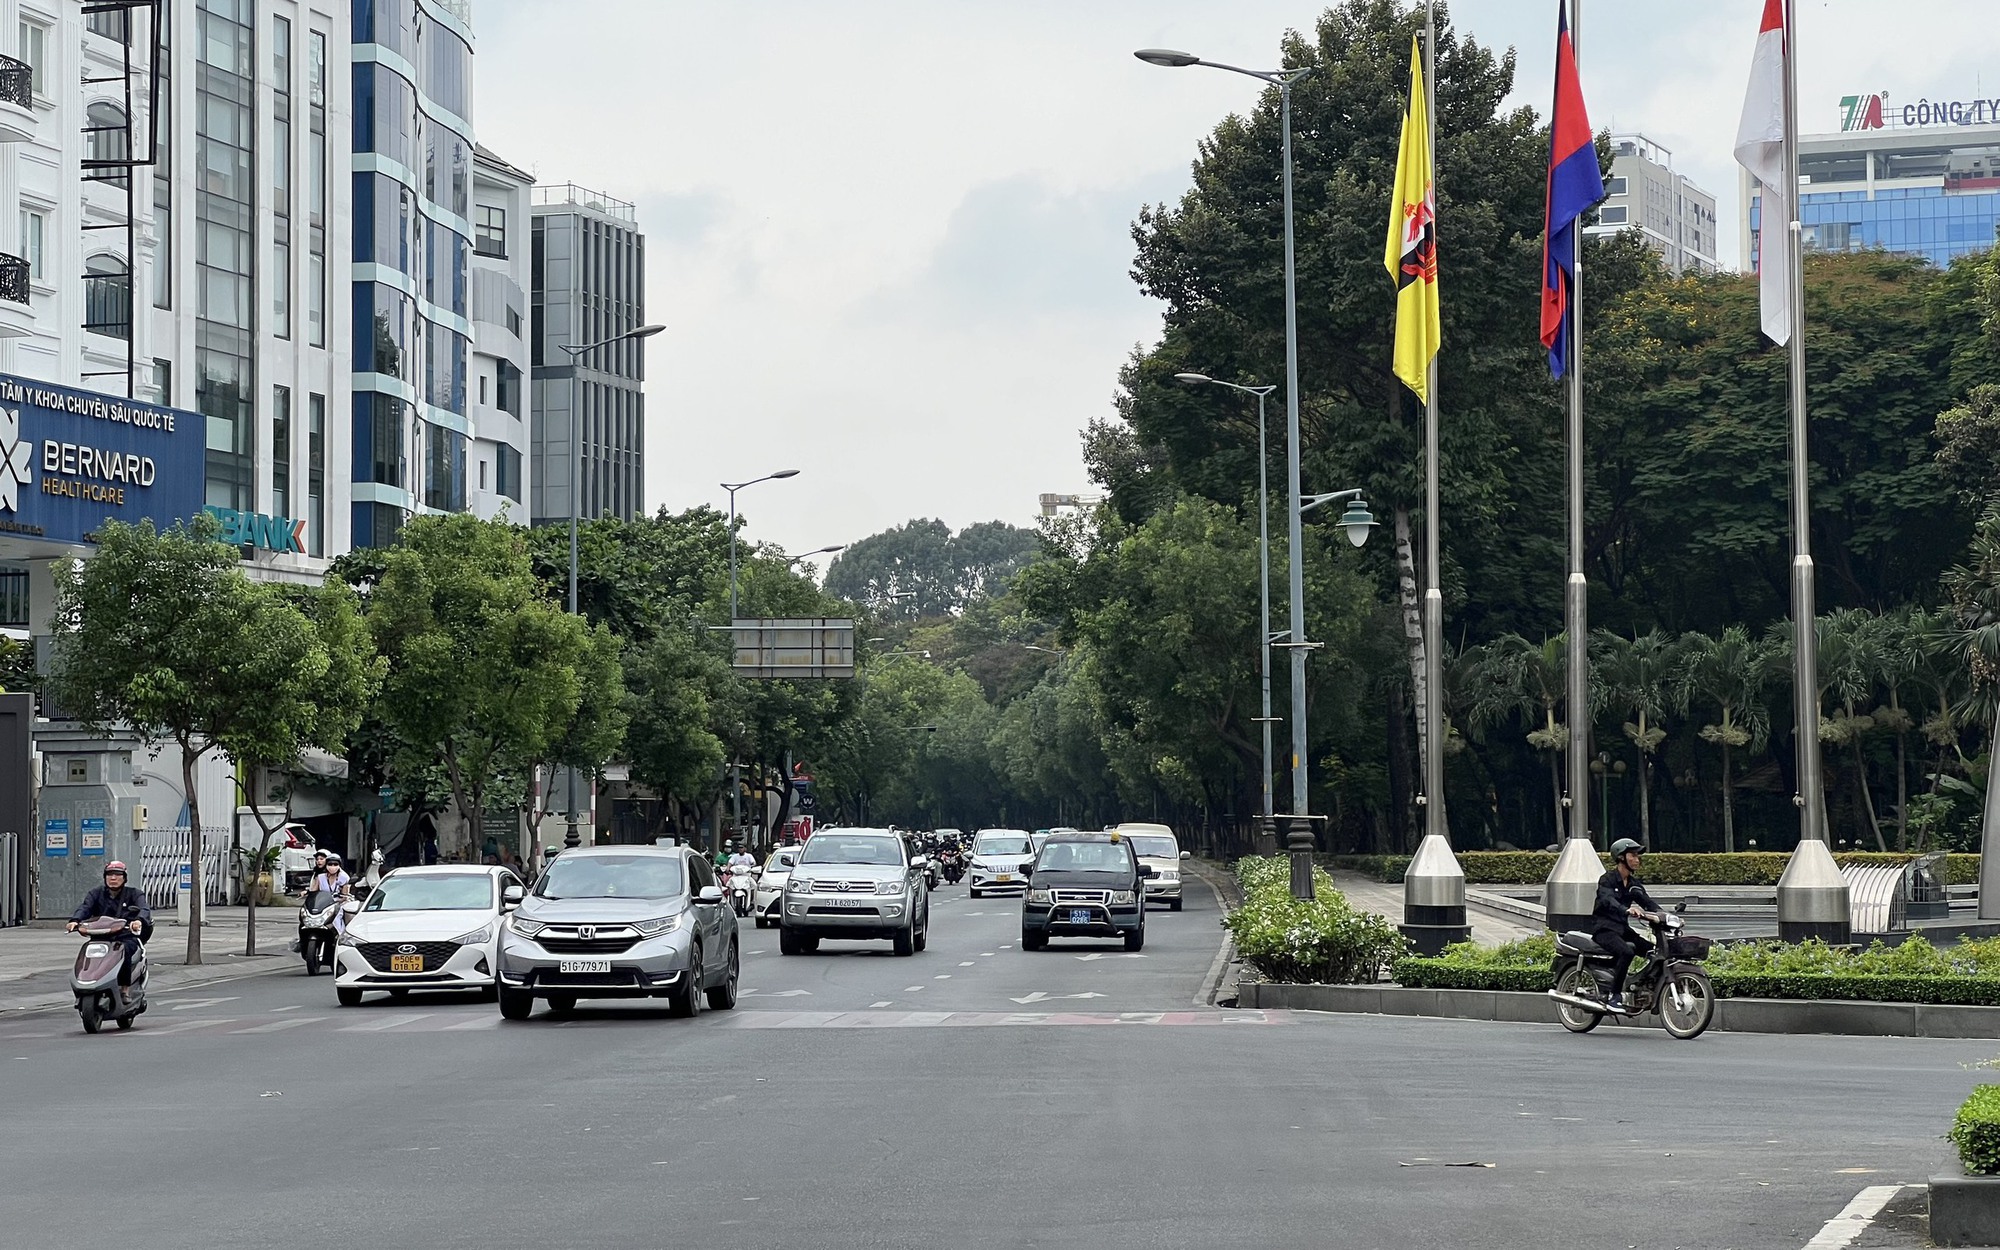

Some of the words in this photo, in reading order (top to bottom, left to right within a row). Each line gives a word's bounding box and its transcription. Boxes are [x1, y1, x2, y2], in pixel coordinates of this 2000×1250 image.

[1903, 98, 1962, 126] CÔNG
[1973, 99, 2000, 121] TY
[1, 379, 23, 402] TÂM
[26, 387, 33, 404] Y
[35, 389, 65, 411] KHOA
[67, 397, 108, 419] CHUYÊN
[110, 402, 131, 423] SÂU
[132, 408, 161, 428] QUỐC
[162, 412, 175, 431] TẾ
[43, 439, 156, 487] BERNARD
[42, 476, 125, 505] HEALTHCARE
